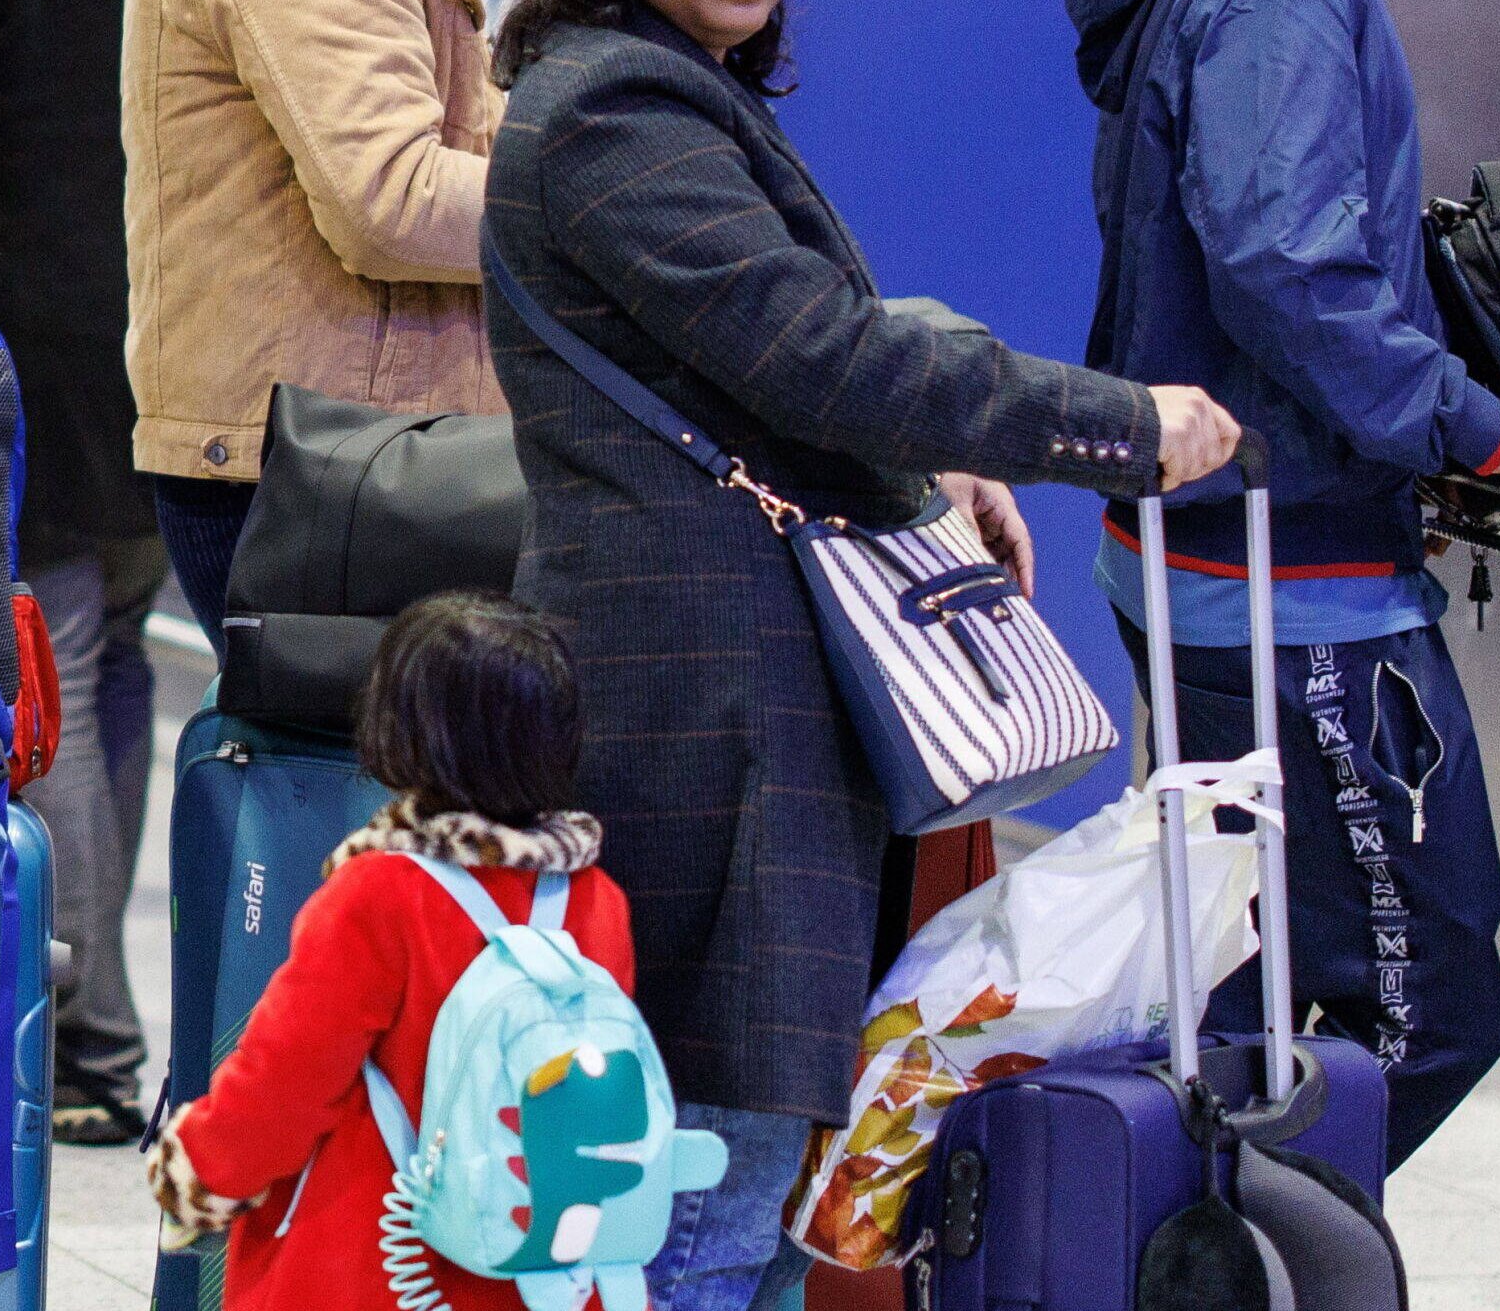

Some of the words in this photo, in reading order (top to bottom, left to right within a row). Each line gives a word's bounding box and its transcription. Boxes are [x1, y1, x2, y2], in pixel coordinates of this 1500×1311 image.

[1305, 672, 1342, 695] MX
[1336, 785, 1371, 804] MX
[243, 860, 266, 936] safari
